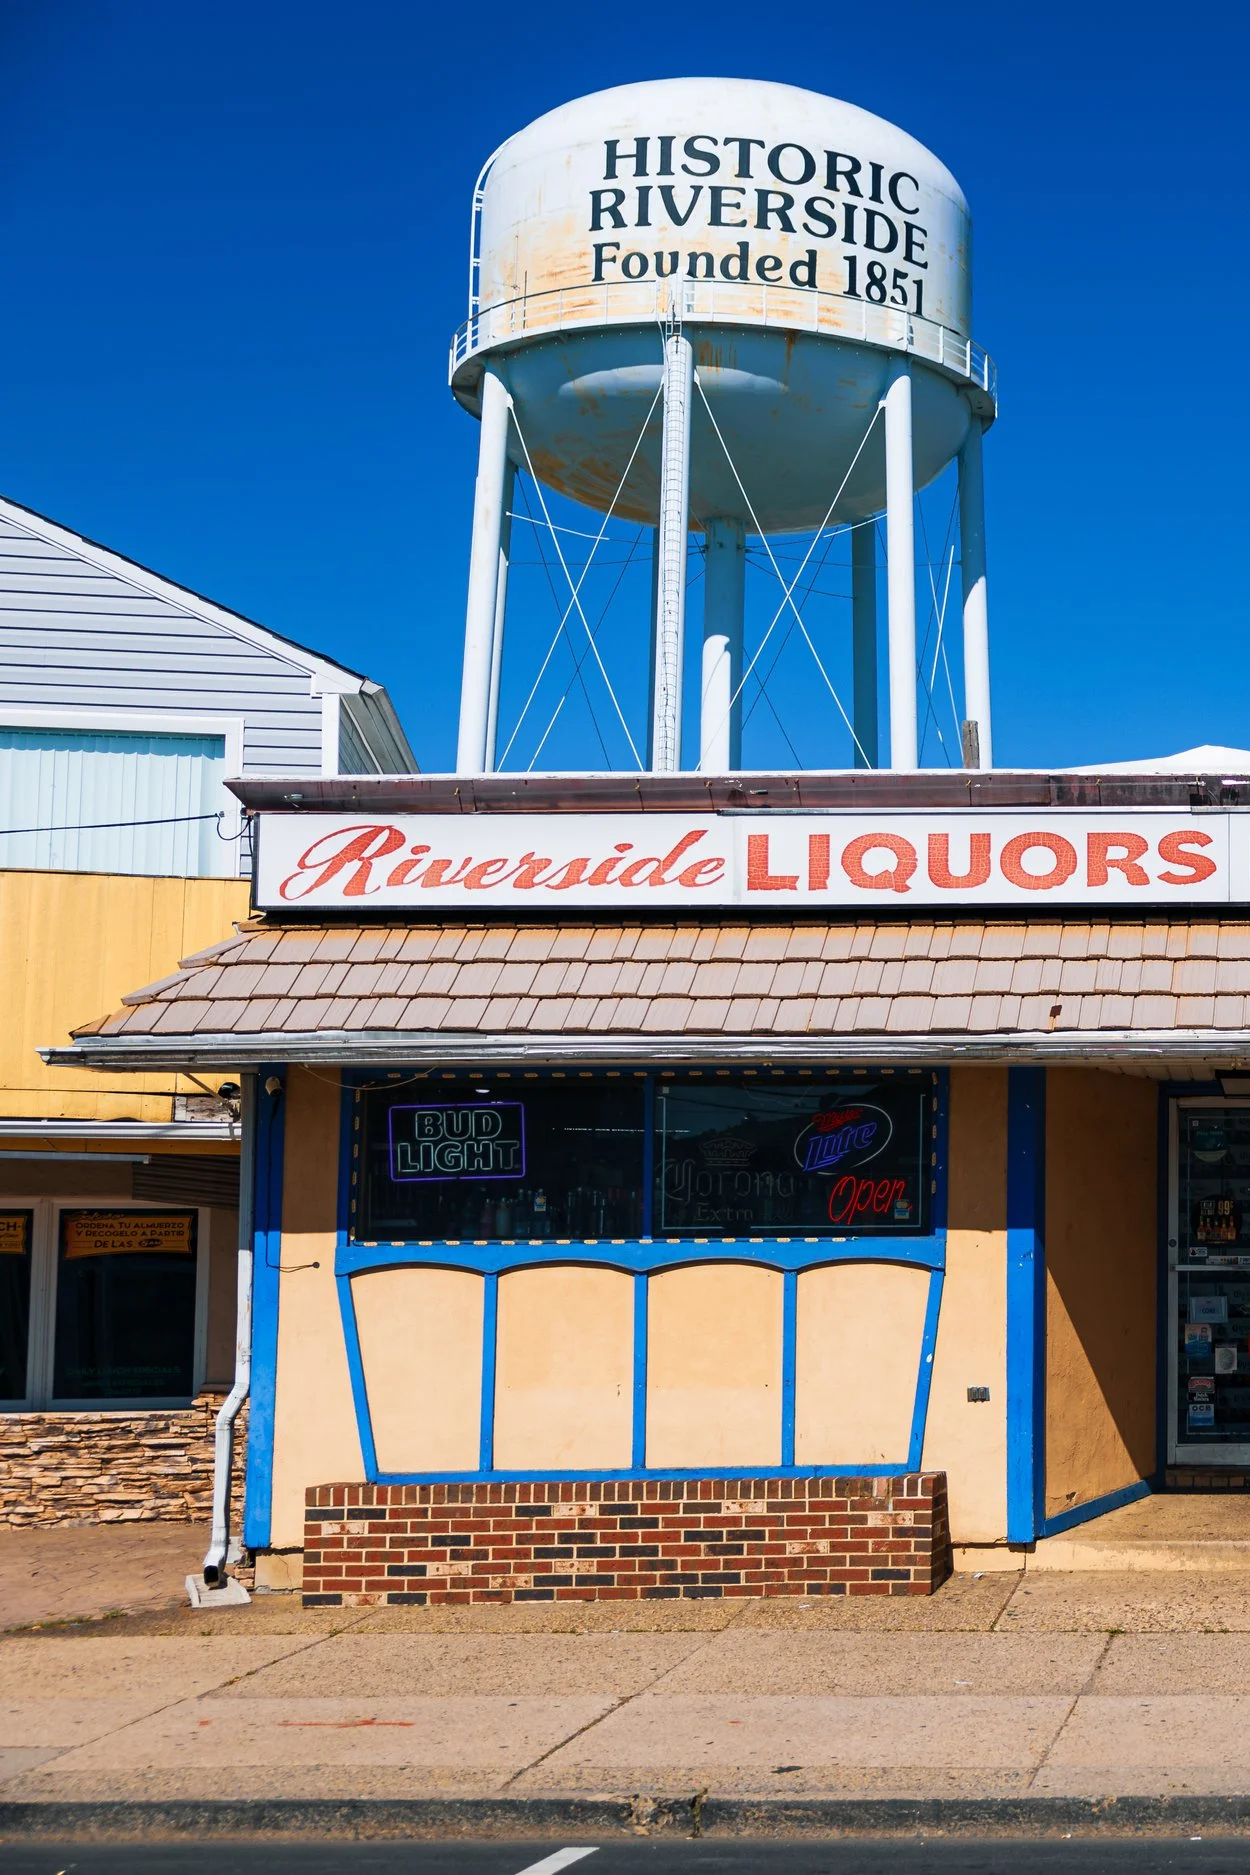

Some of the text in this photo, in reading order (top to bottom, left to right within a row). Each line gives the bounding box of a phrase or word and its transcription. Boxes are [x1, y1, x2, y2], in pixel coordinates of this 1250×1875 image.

[602, 134, 920, 216] HISTORIC
[588, 184, 928, 270] RIVERSIDE
[592, 241, 925, 316] Founded 1851
[278, 824, 726, 901] Riverside
[747, 829, 1218, 893] LIQUORS
[415, 1109, 502, 1140] BUD
[397, 1140, 520, 1172] LIGHT
[655, 1158, 796, 1206] Corona
[829, 1175, 909, 1226] Open
[694, 1203, 754, 1222] Extra
